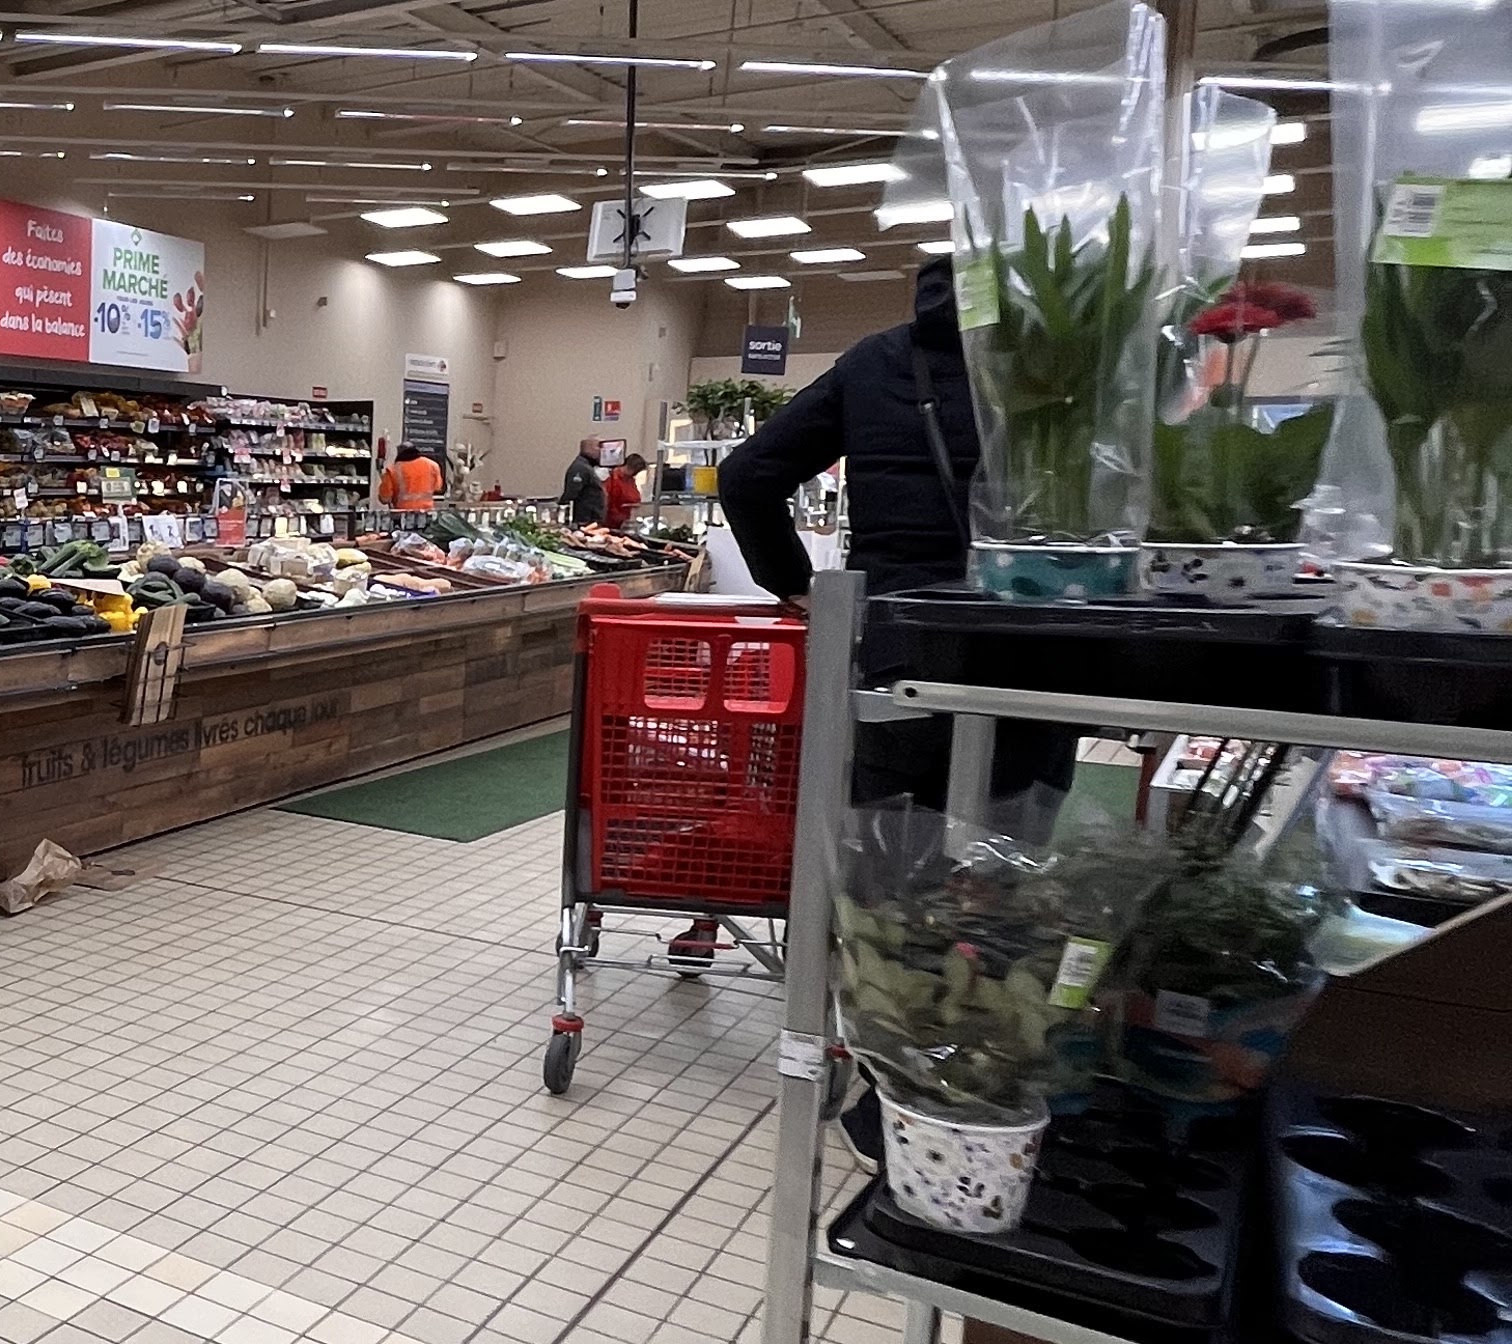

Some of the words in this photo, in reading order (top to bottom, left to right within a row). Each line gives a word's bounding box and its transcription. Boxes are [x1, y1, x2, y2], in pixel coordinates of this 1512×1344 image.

[27, 219, 63, 244] Faites
[2, 246, 24, 266] des
[26, 248, 82, 276] économies
[113, 247, 159, 275] PRIME
[15, 284, 34, 304] qui
[35, 285, 73, 308] pèsent
[103, 269, 168, 299] MARCHÉ
[0, 310, 29, 330] dans
[31, 313, 43, 333] la
[45, 316, 86, 337] balance
[749, 340, 782, 351] sortie
